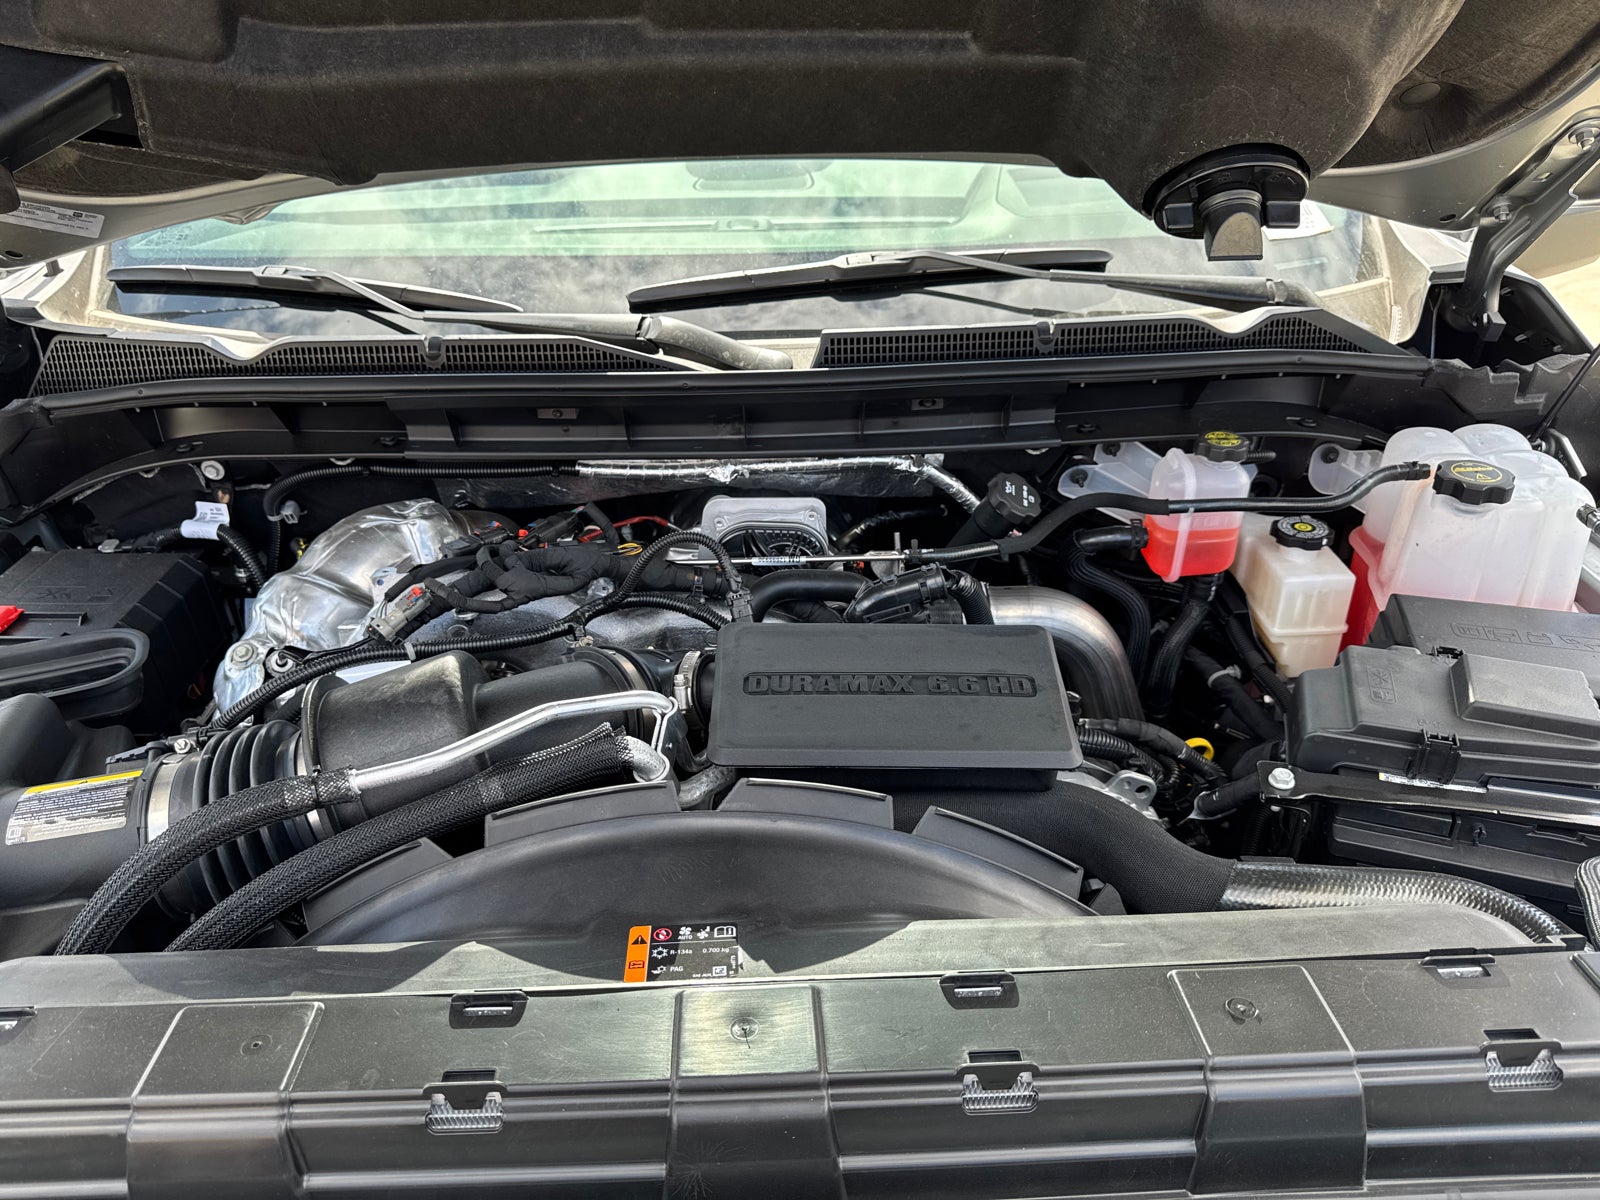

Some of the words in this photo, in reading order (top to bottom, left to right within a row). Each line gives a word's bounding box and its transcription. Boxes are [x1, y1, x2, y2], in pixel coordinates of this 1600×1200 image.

[746, 674, 915, 694] DURAMAX
[927, 675, 981, 695] 6.6
[986, 677, 1034, 695] HD
